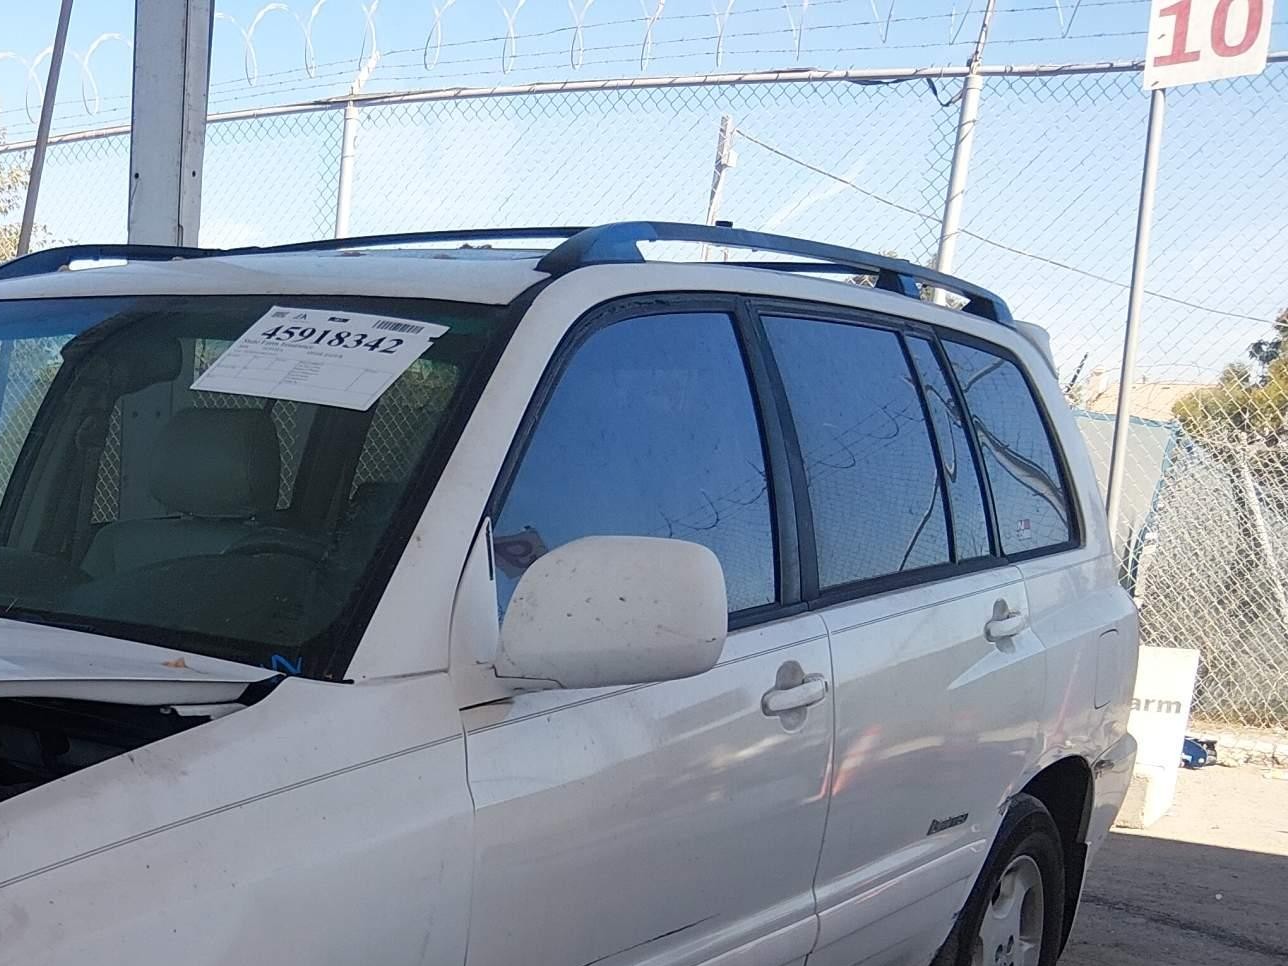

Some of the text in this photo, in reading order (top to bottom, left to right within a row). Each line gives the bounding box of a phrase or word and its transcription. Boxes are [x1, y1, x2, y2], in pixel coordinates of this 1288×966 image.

[1153, 0, 1264, 67] 10
[261, 325, 404, 354] 45918342
[1127, 698, 1182, 714] arm
